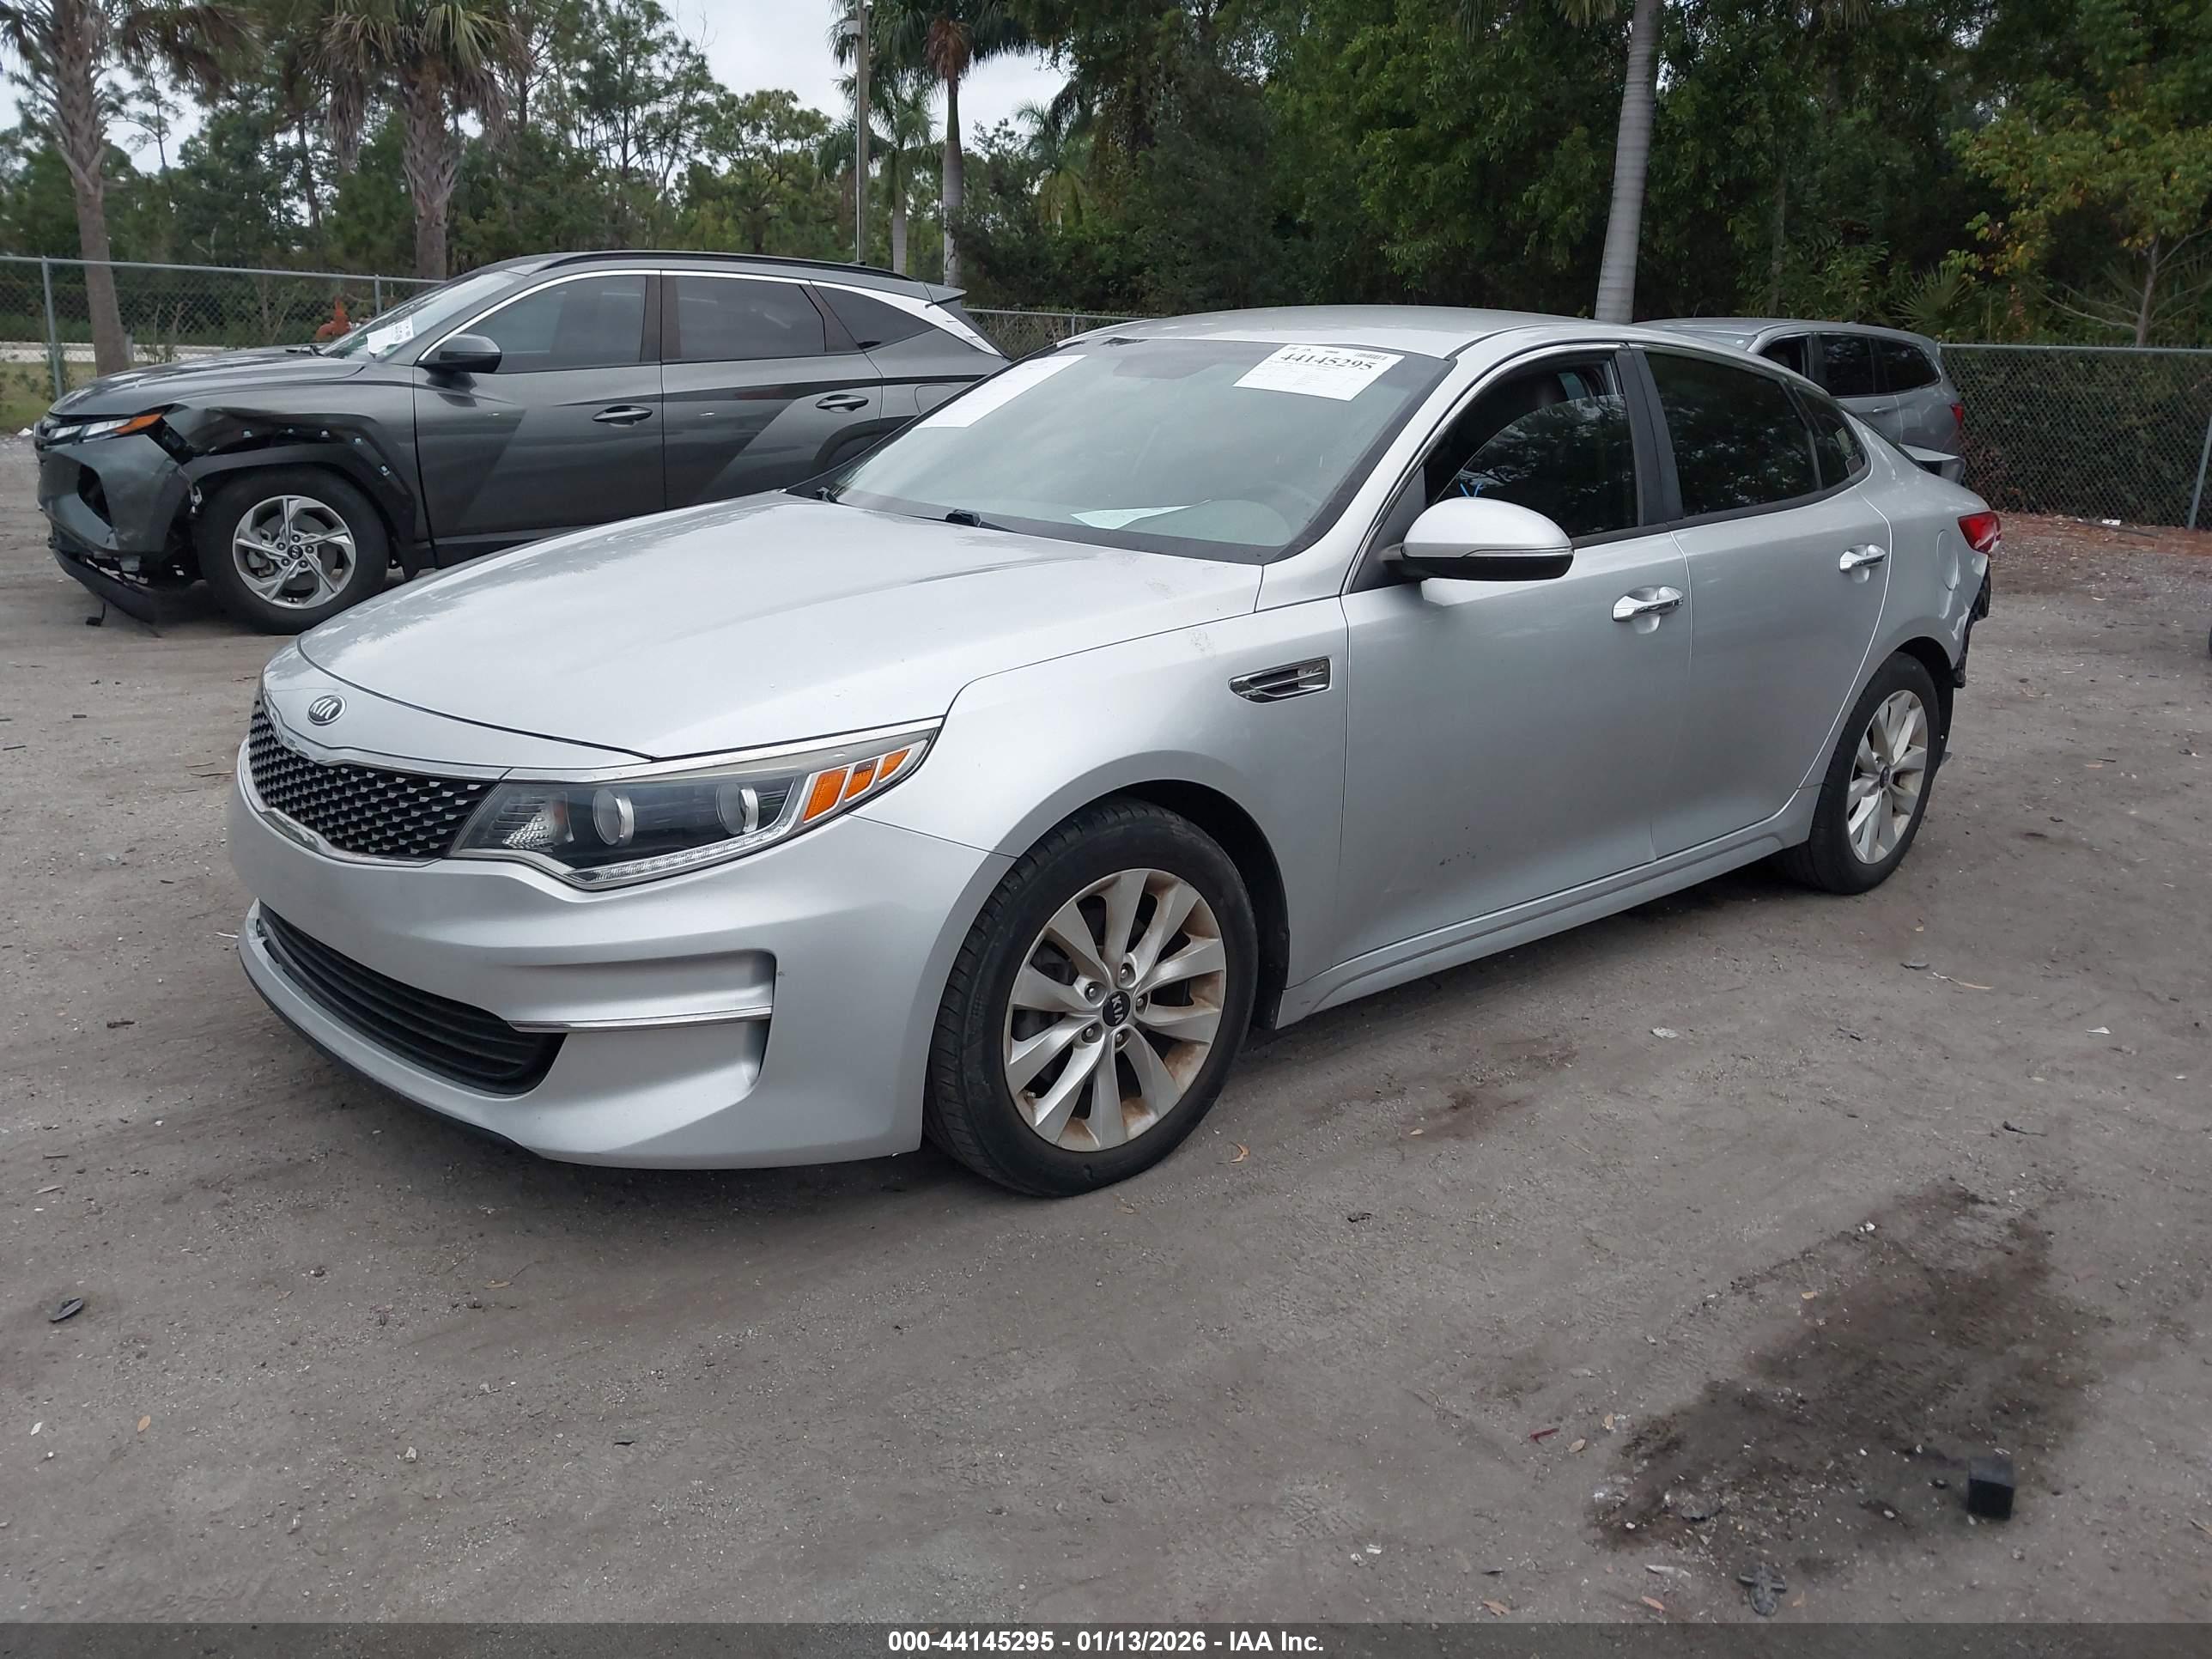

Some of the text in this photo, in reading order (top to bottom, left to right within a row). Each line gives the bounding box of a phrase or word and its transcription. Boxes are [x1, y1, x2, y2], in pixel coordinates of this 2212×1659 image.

[1279, 352, 1378, 371] 44145295
[309, 697, 338, 720] KIA
[1111, 994, 1124, 1024] KIA
